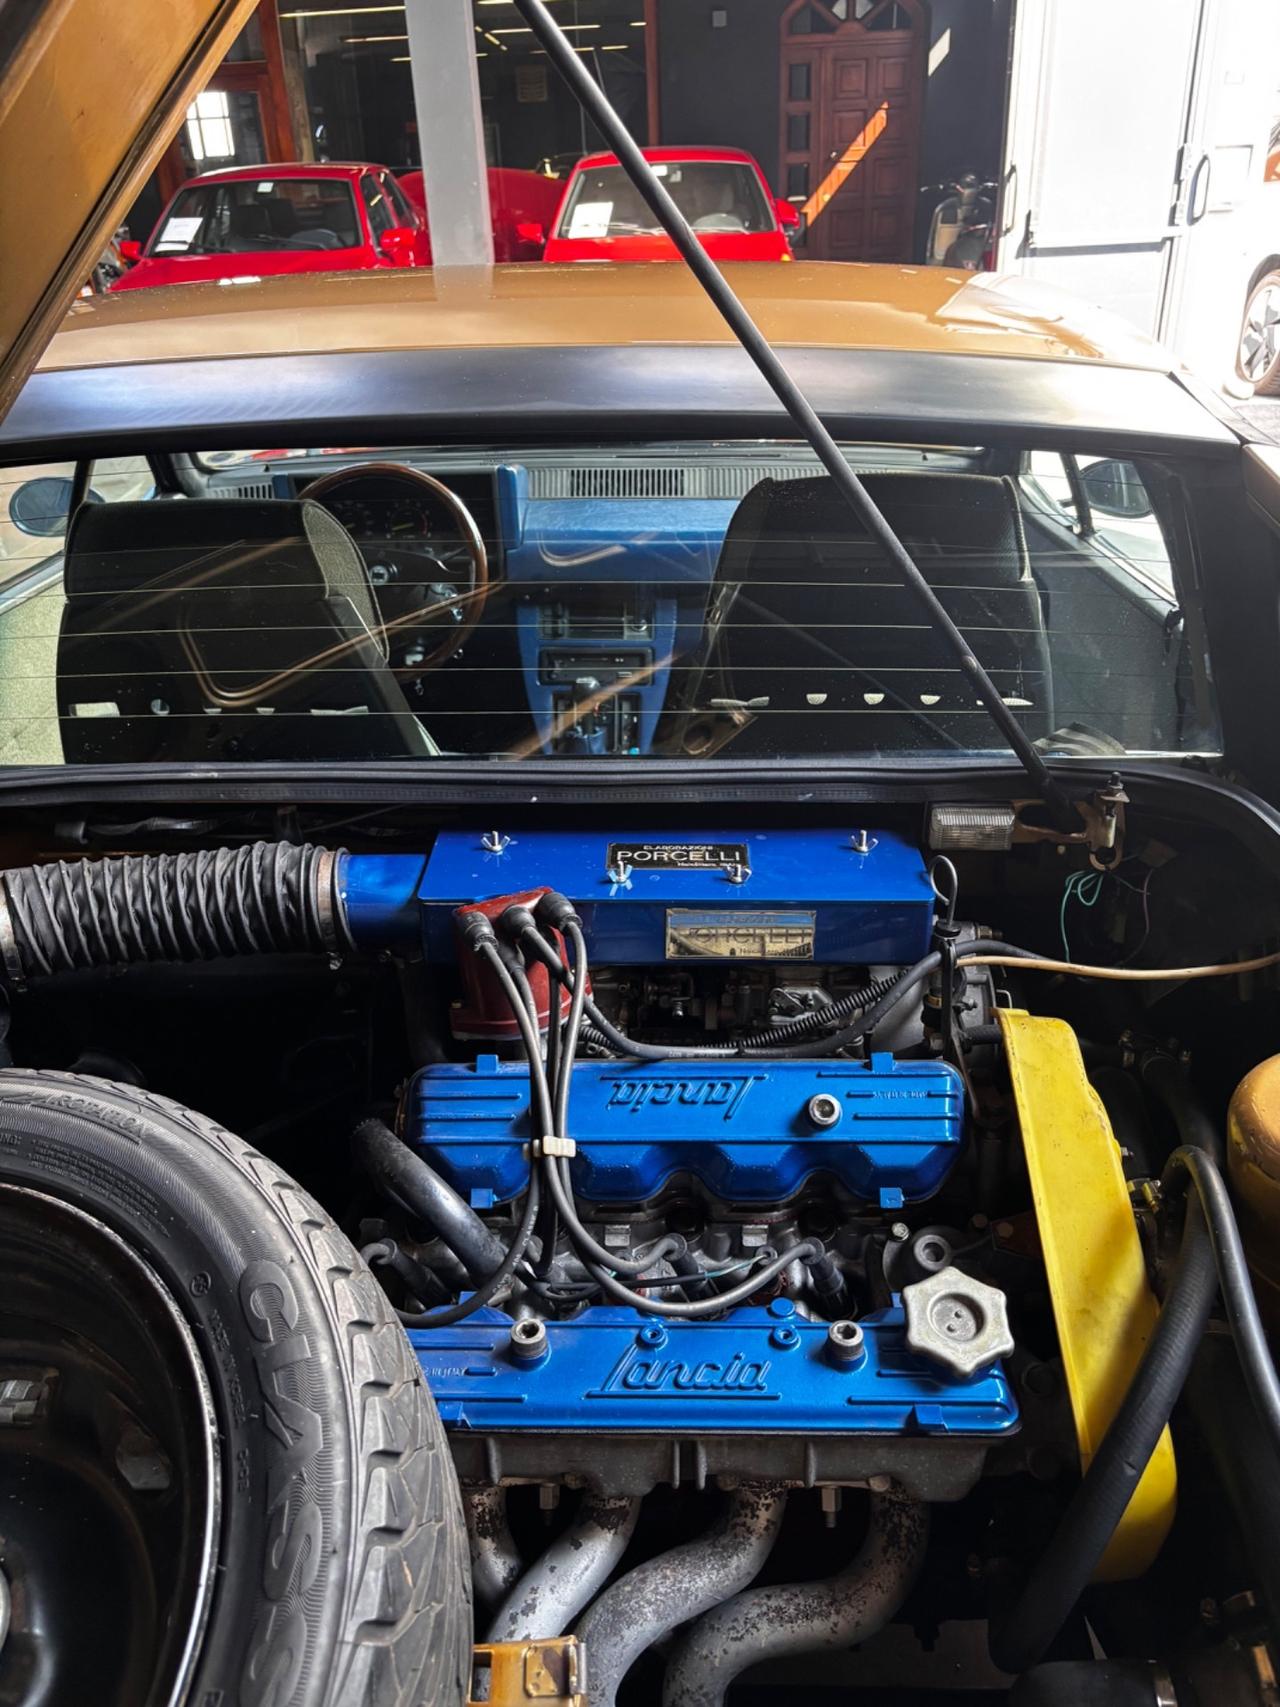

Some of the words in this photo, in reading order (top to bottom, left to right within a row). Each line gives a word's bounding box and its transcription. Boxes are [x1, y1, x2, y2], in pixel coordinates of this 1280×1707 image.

[617, 850, 741, 861] PORCELLI
[602, 1075, 760, 1121] Lancia
[598, 1344, 773, 1398] Lancia
